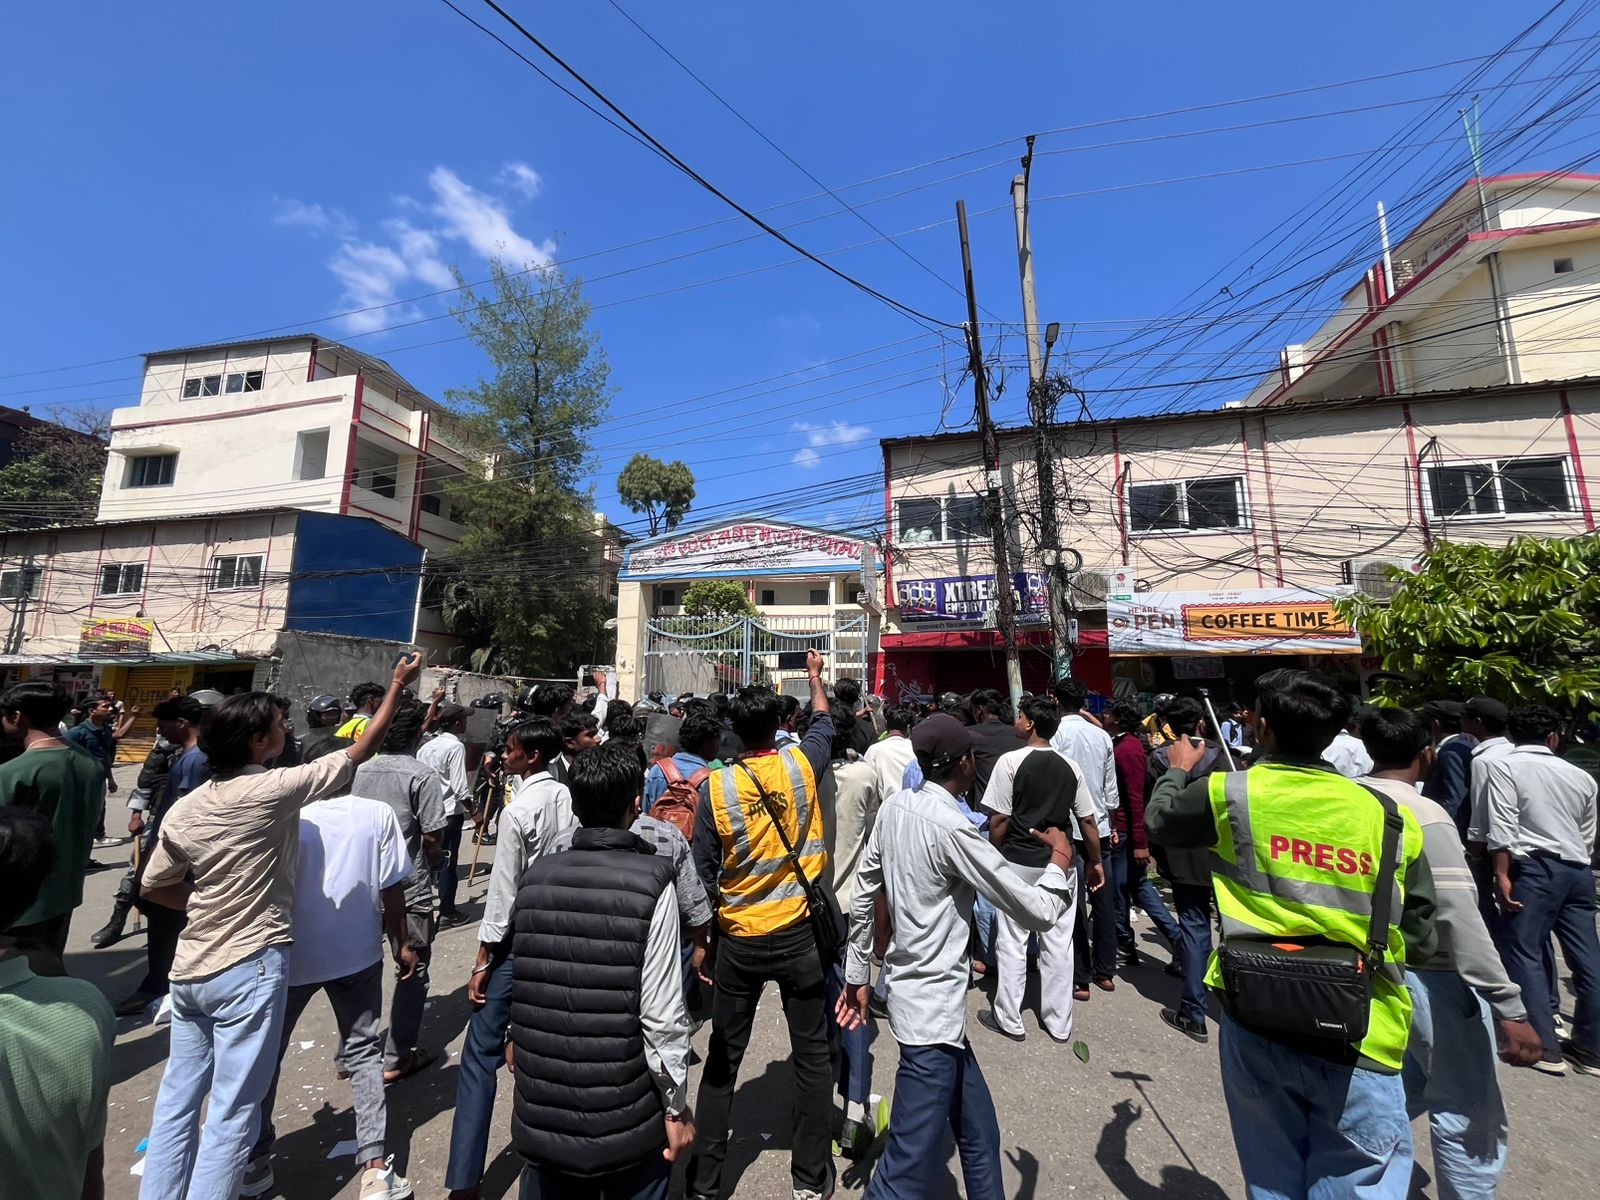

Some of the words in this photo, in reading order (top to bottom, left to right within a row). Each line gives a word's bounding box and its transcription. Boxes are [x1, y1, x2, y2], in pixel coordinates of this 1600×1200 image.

[944, 578, 1015, 602] XTREM
[945, 600, 983, 614] ENERGY
[1201, 612, 1278, 629] COFFEE
[1282, 611, 1332, 628] TIME
[1269, 834, 1373, 876] PRESS
